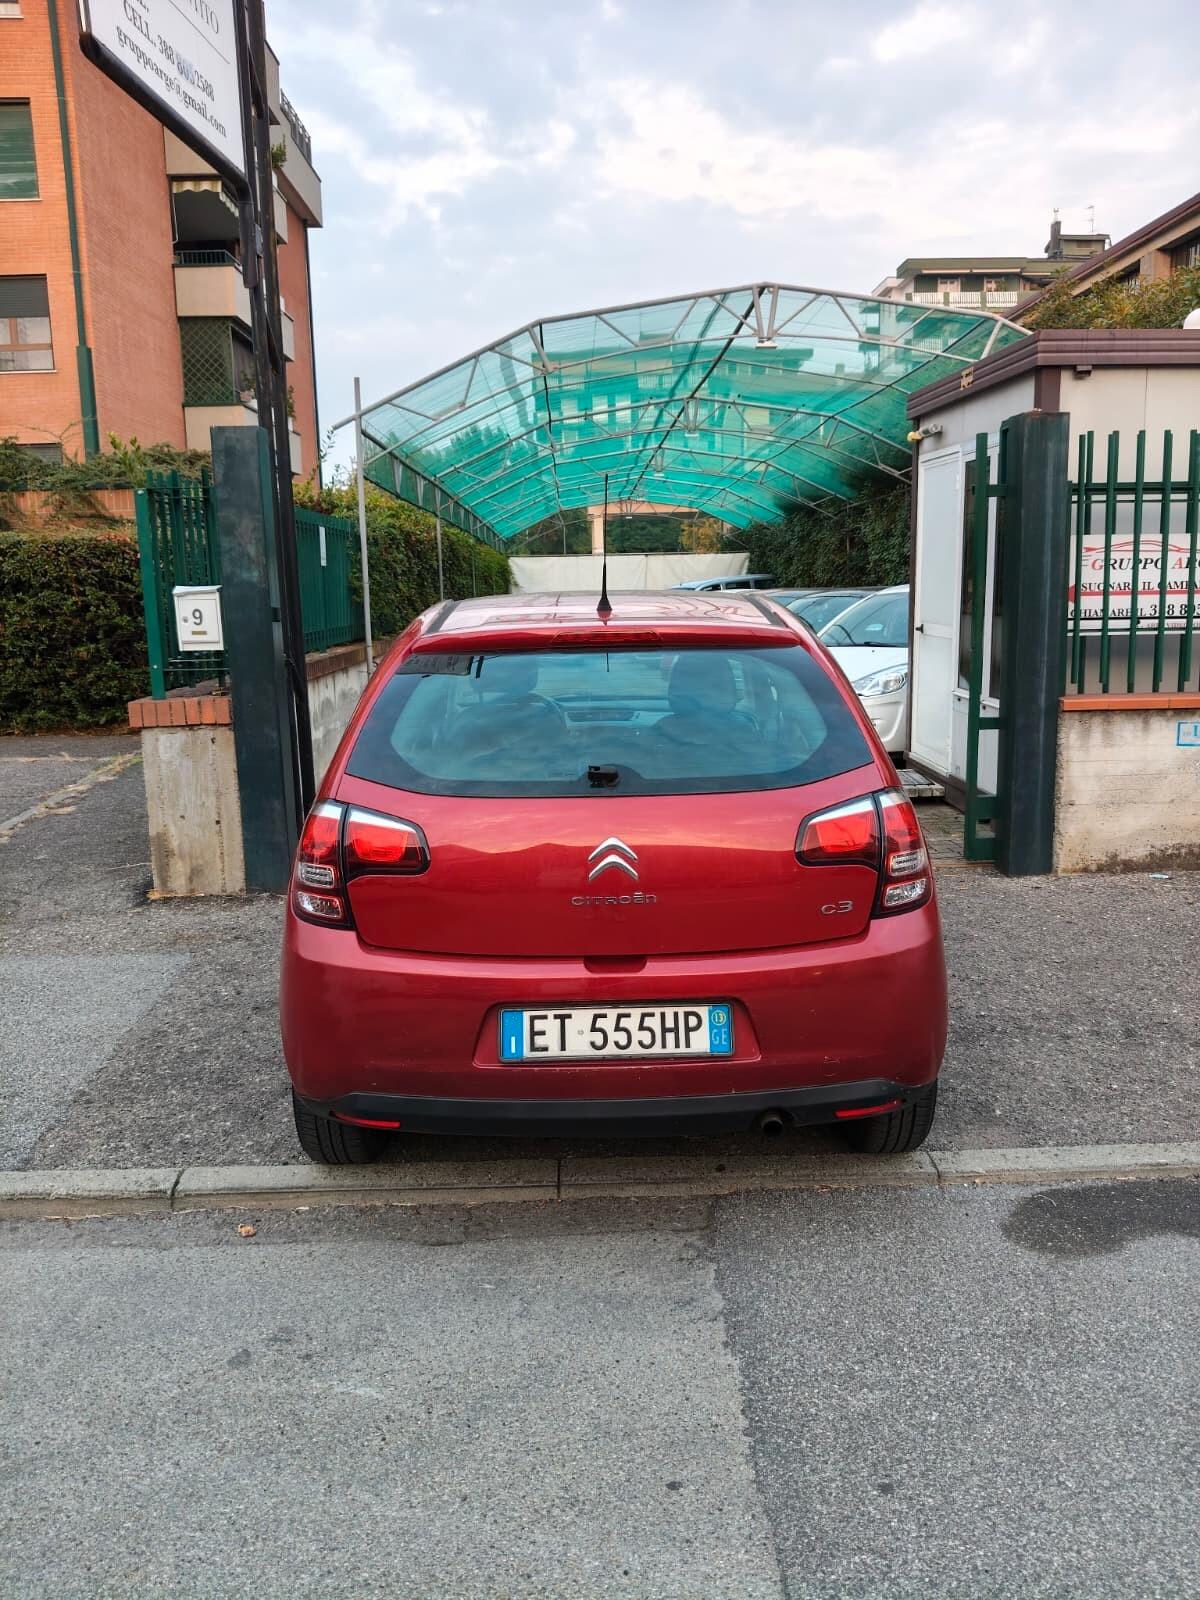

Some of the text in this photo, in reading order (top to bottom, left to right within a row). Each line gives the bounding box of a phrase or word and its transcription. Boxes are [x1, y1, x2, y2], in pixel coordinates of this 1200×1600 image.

[123, 0, 157, 48] CELL.
[192, 608, 204, 626] 9
[821, 900, 853, 915] C3
[714, 1013, 725, 1023] 13
[529, 1013, 573, 1053] ET
[589, 1010, 703, 1052] 555HP
[711, 1028, 729, 1046] GE
